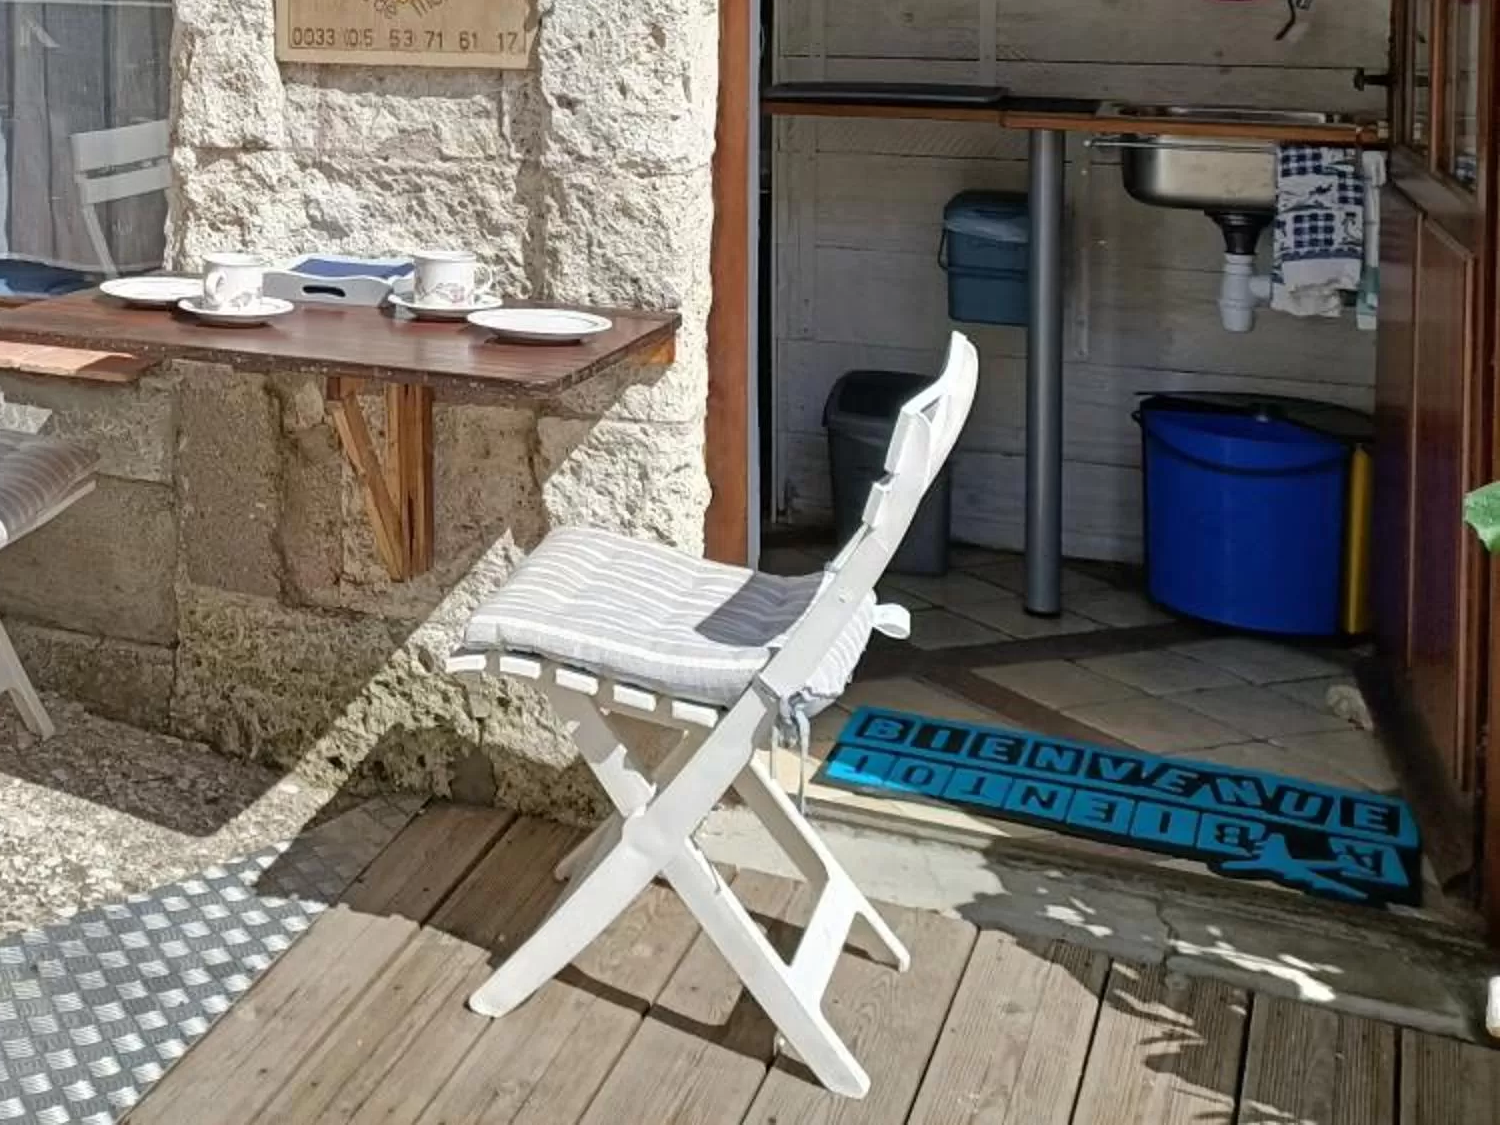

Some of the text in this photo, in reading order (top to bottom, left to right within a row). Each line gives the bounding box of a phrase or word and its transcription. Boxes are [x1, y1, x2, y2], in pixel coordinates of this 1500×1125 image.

[292, 26, 337, 47] 0033
[388, 27, 414, 49] 53
[423, 29, 444, 49] 71
[459, 30, 479, 52] 61
[497, 31, 520, 53] 17
[863, 717, 1393, 832] BIENVENUE
